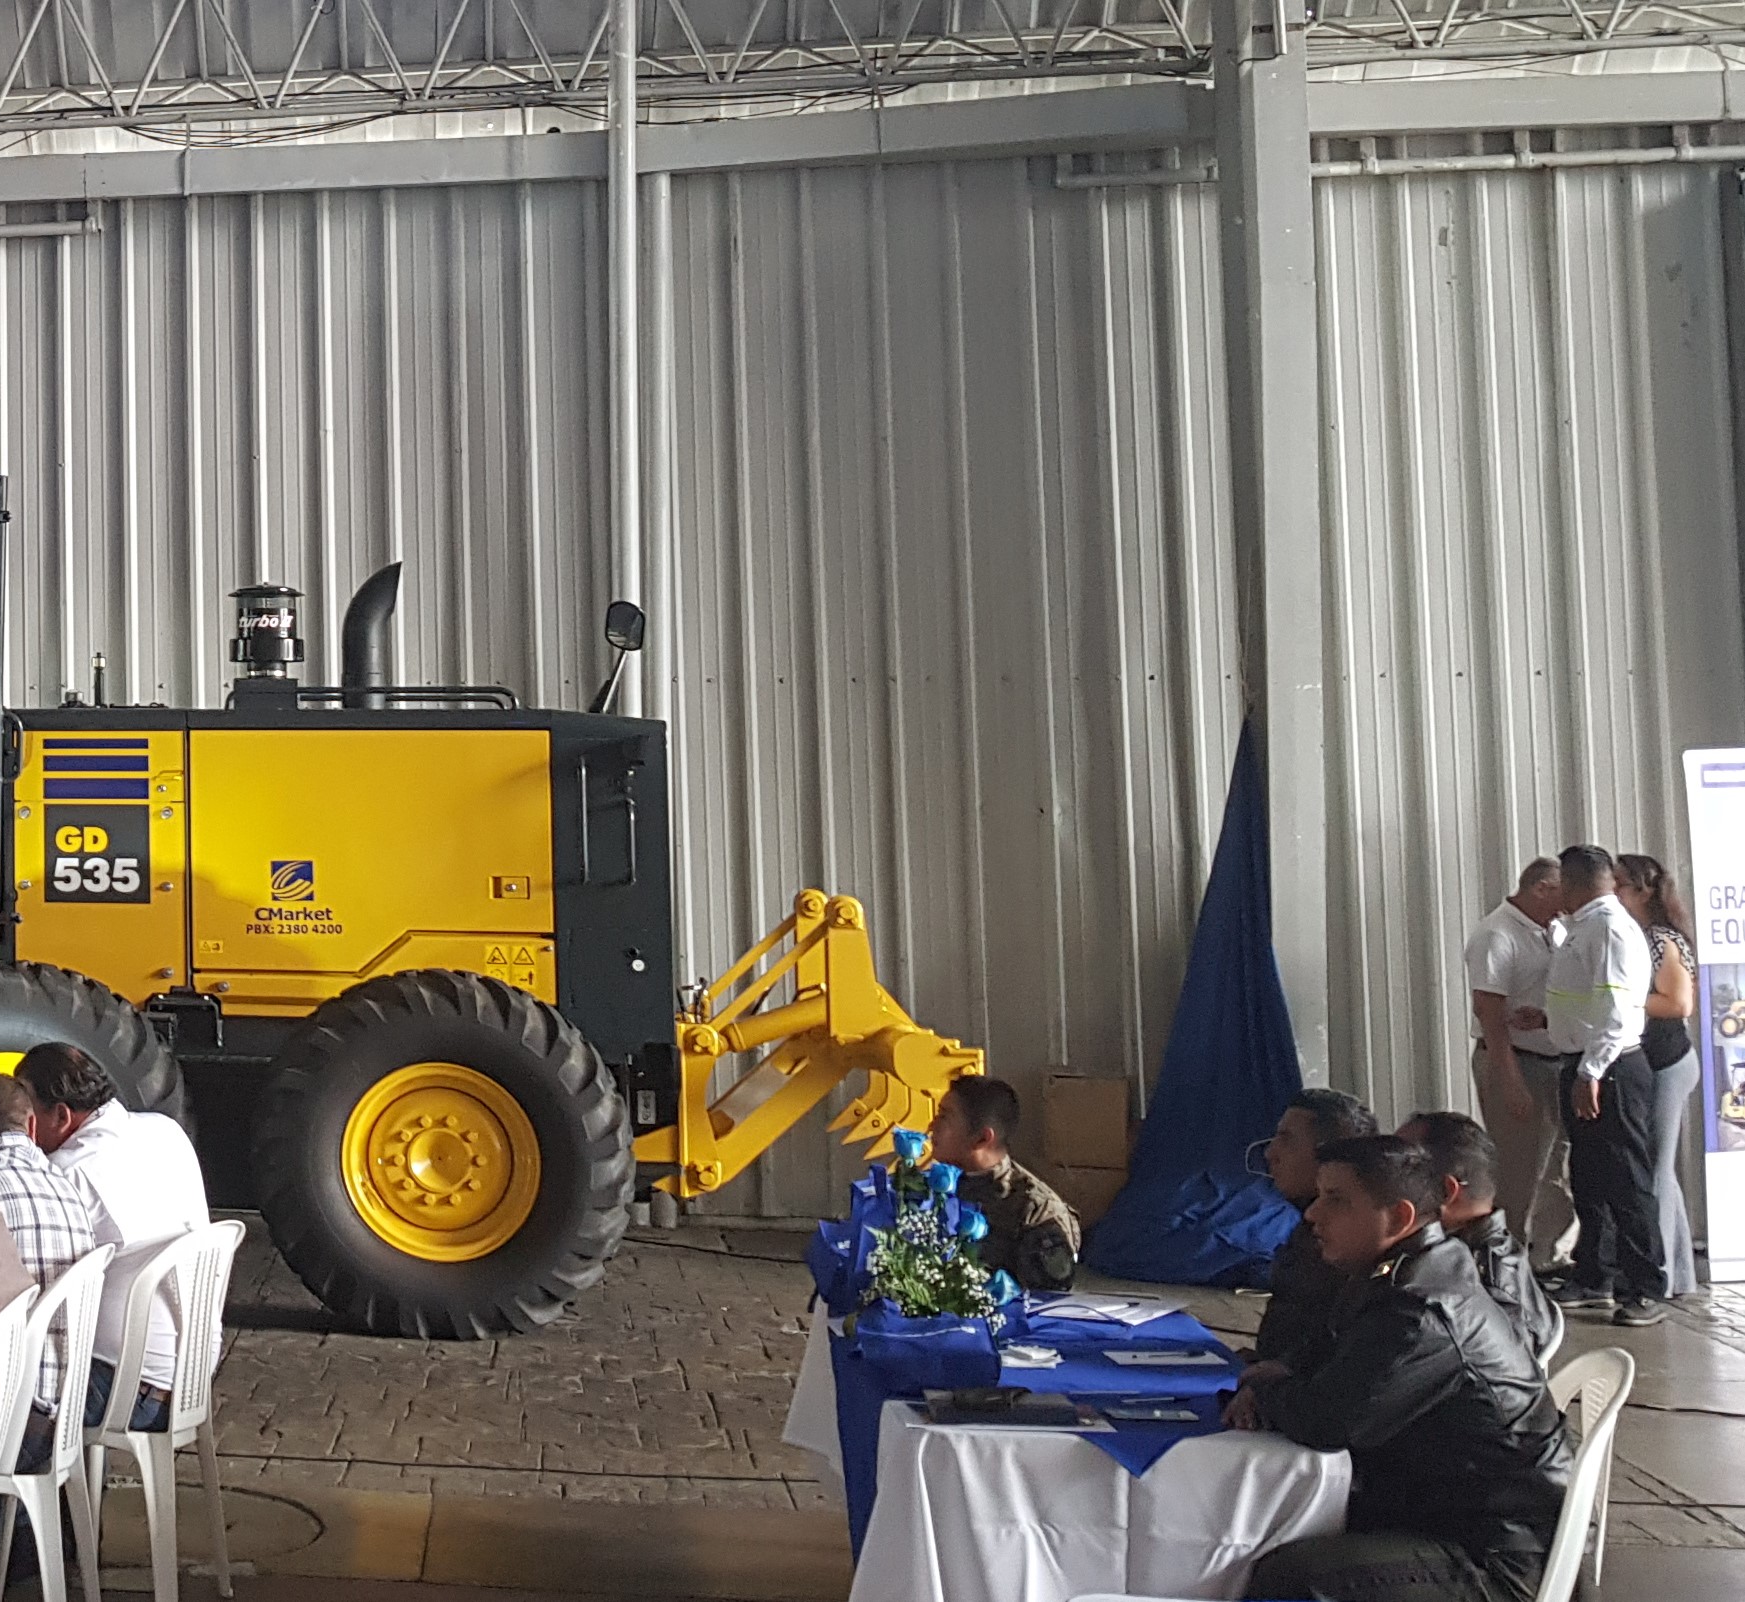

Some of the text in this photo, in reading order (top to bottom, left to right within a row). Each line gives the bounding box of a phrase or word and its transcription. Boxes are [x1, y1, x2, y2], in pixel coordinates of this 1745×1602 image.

[239, 613, 279, 628] turbo
[55, 825, 109, 854] GD
[53, 857, 141, 893] 535
[254, 906, 333, 921] CMarket
[246, 924, 343, 934] PBX: 2380 4200
